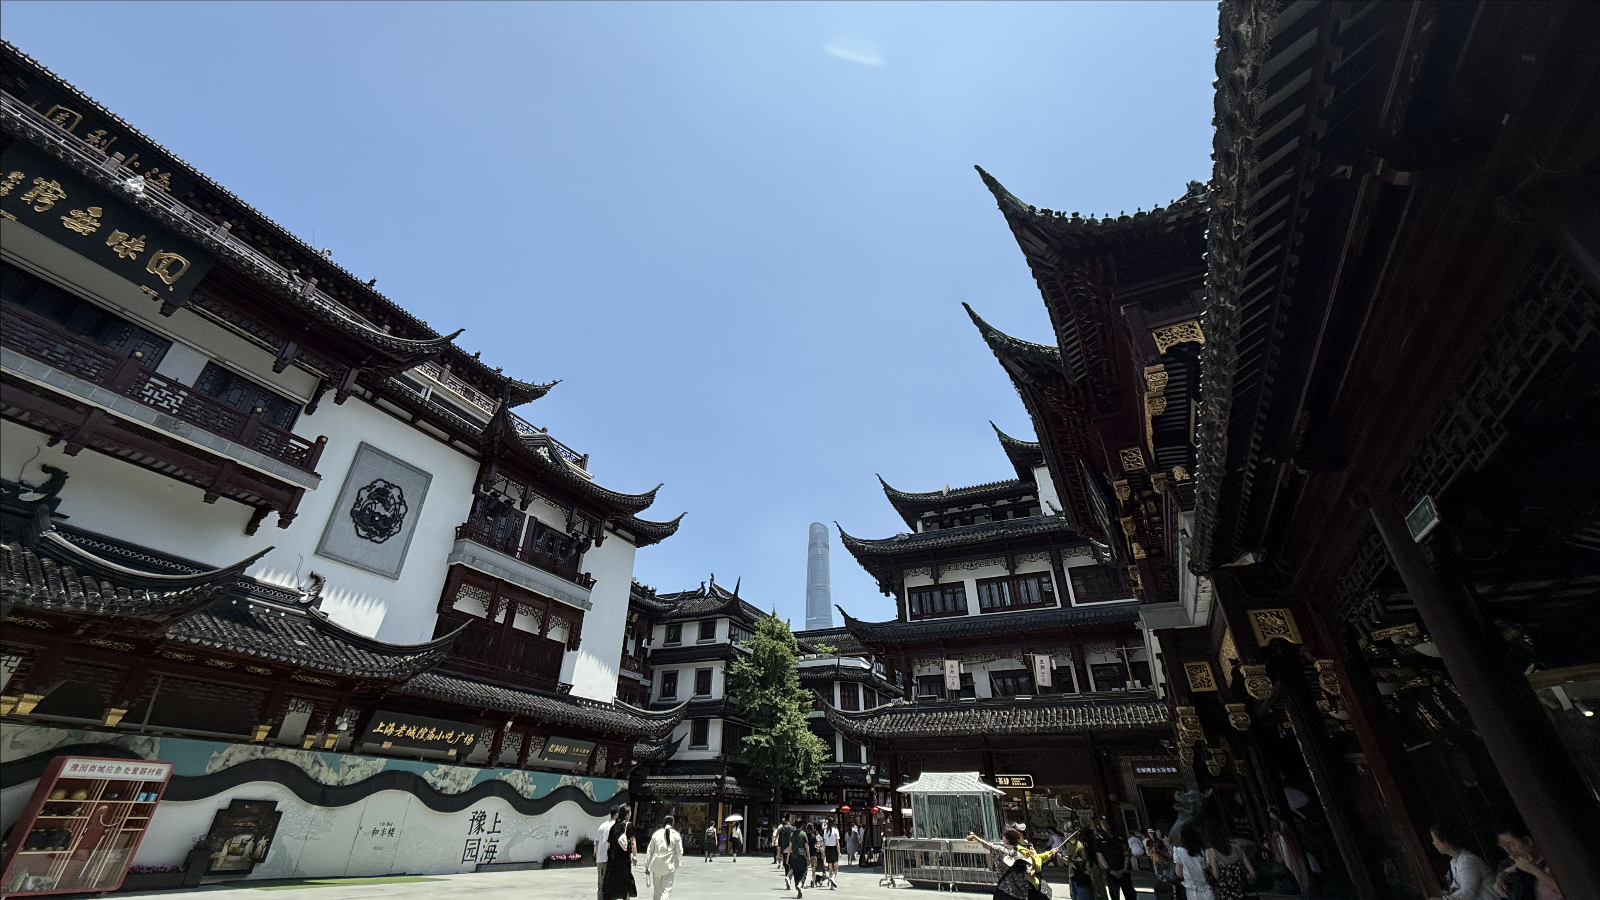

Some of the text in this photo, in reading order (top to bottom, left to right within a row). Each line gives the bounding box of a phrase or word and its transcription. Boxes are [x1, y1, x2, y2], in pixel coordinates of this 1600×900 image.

[372, 721, 475, 746] 上海老城隍庙小吃广场
[70, 763, 164, 776] 豫园商城应急处置器材箱
